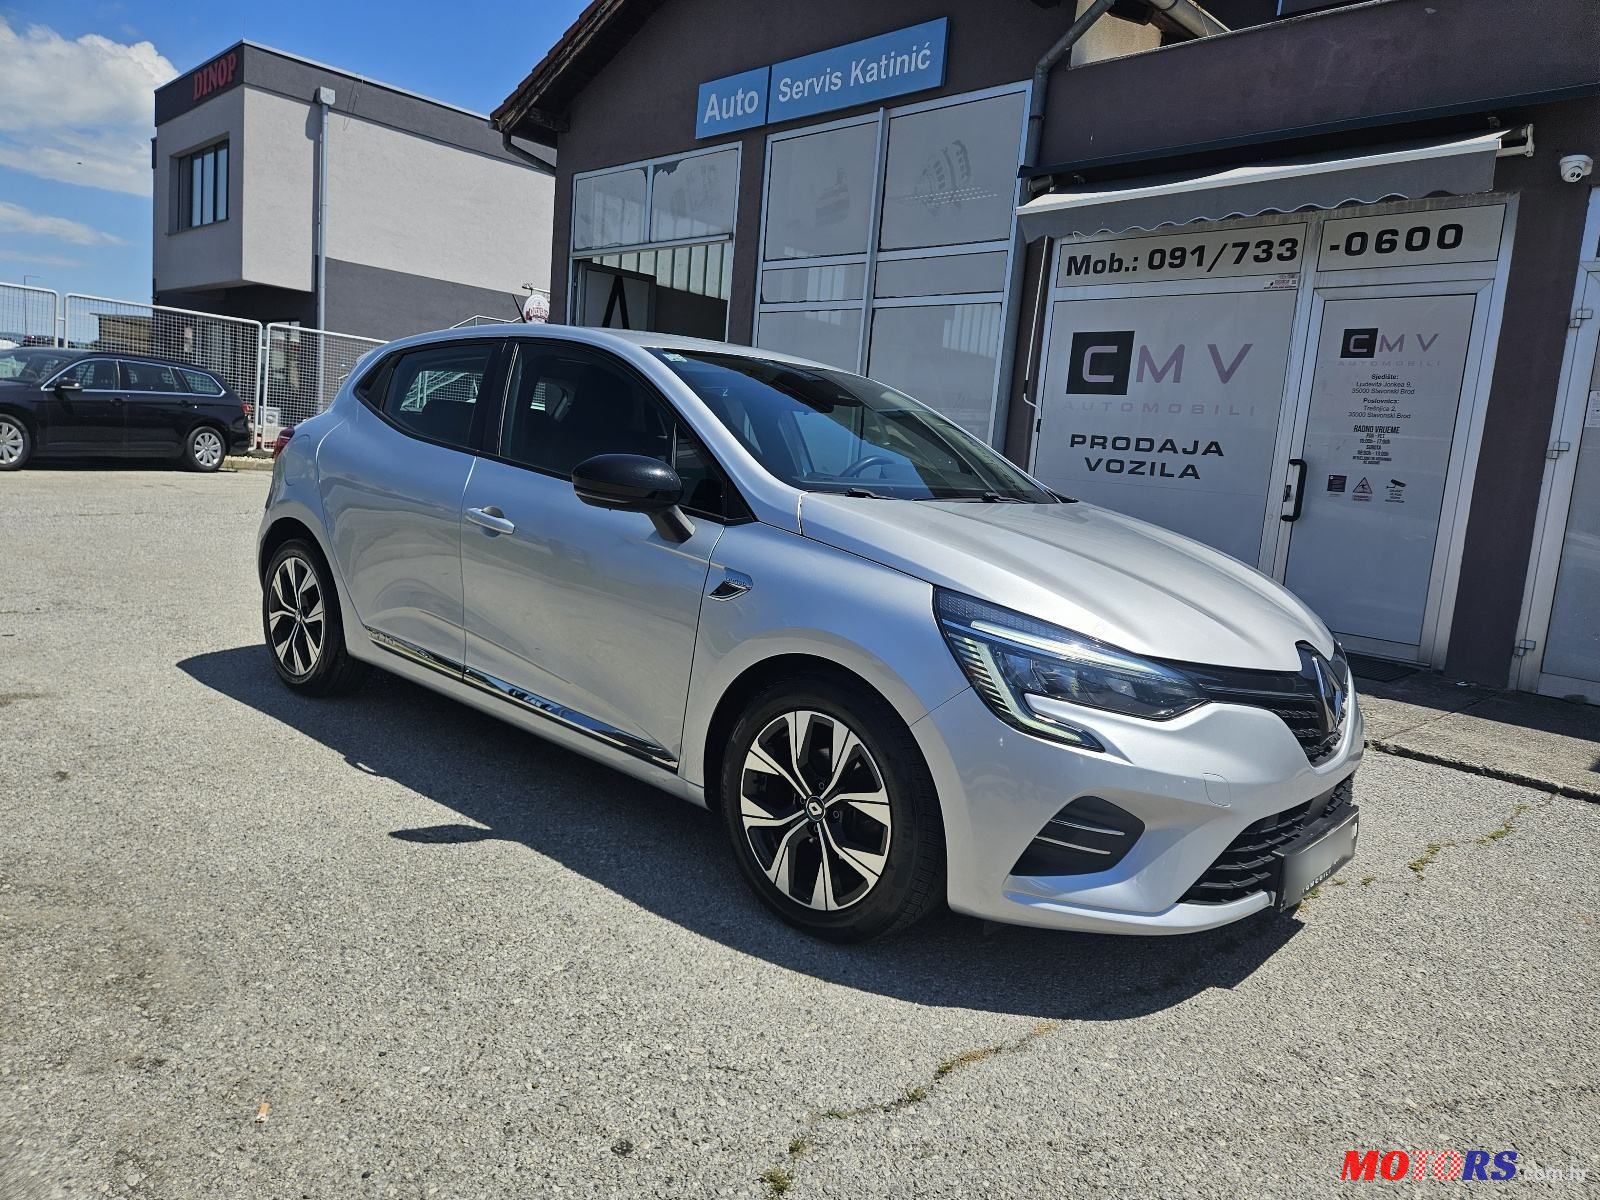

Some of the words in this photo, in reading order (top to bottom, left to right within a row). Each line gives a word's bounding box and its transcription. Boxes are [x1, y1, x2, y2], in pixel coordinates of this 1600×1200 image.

[193, 53, 237, 101] DINOP
[703, 86, 759, 124] Auto
[778, 67, 842, 103] Servis
[850, 42, 931, 87] Katinić
[1066, 252, 1138, 276] Mob.:
[1063, 400, 1255, 417] AUTOMOBILI
[1353, 424, 1374, 433] RADNO
[1069, 434, 1224, 457] PRODAJA
[1084, 457, 1201, 480] VOZILA
